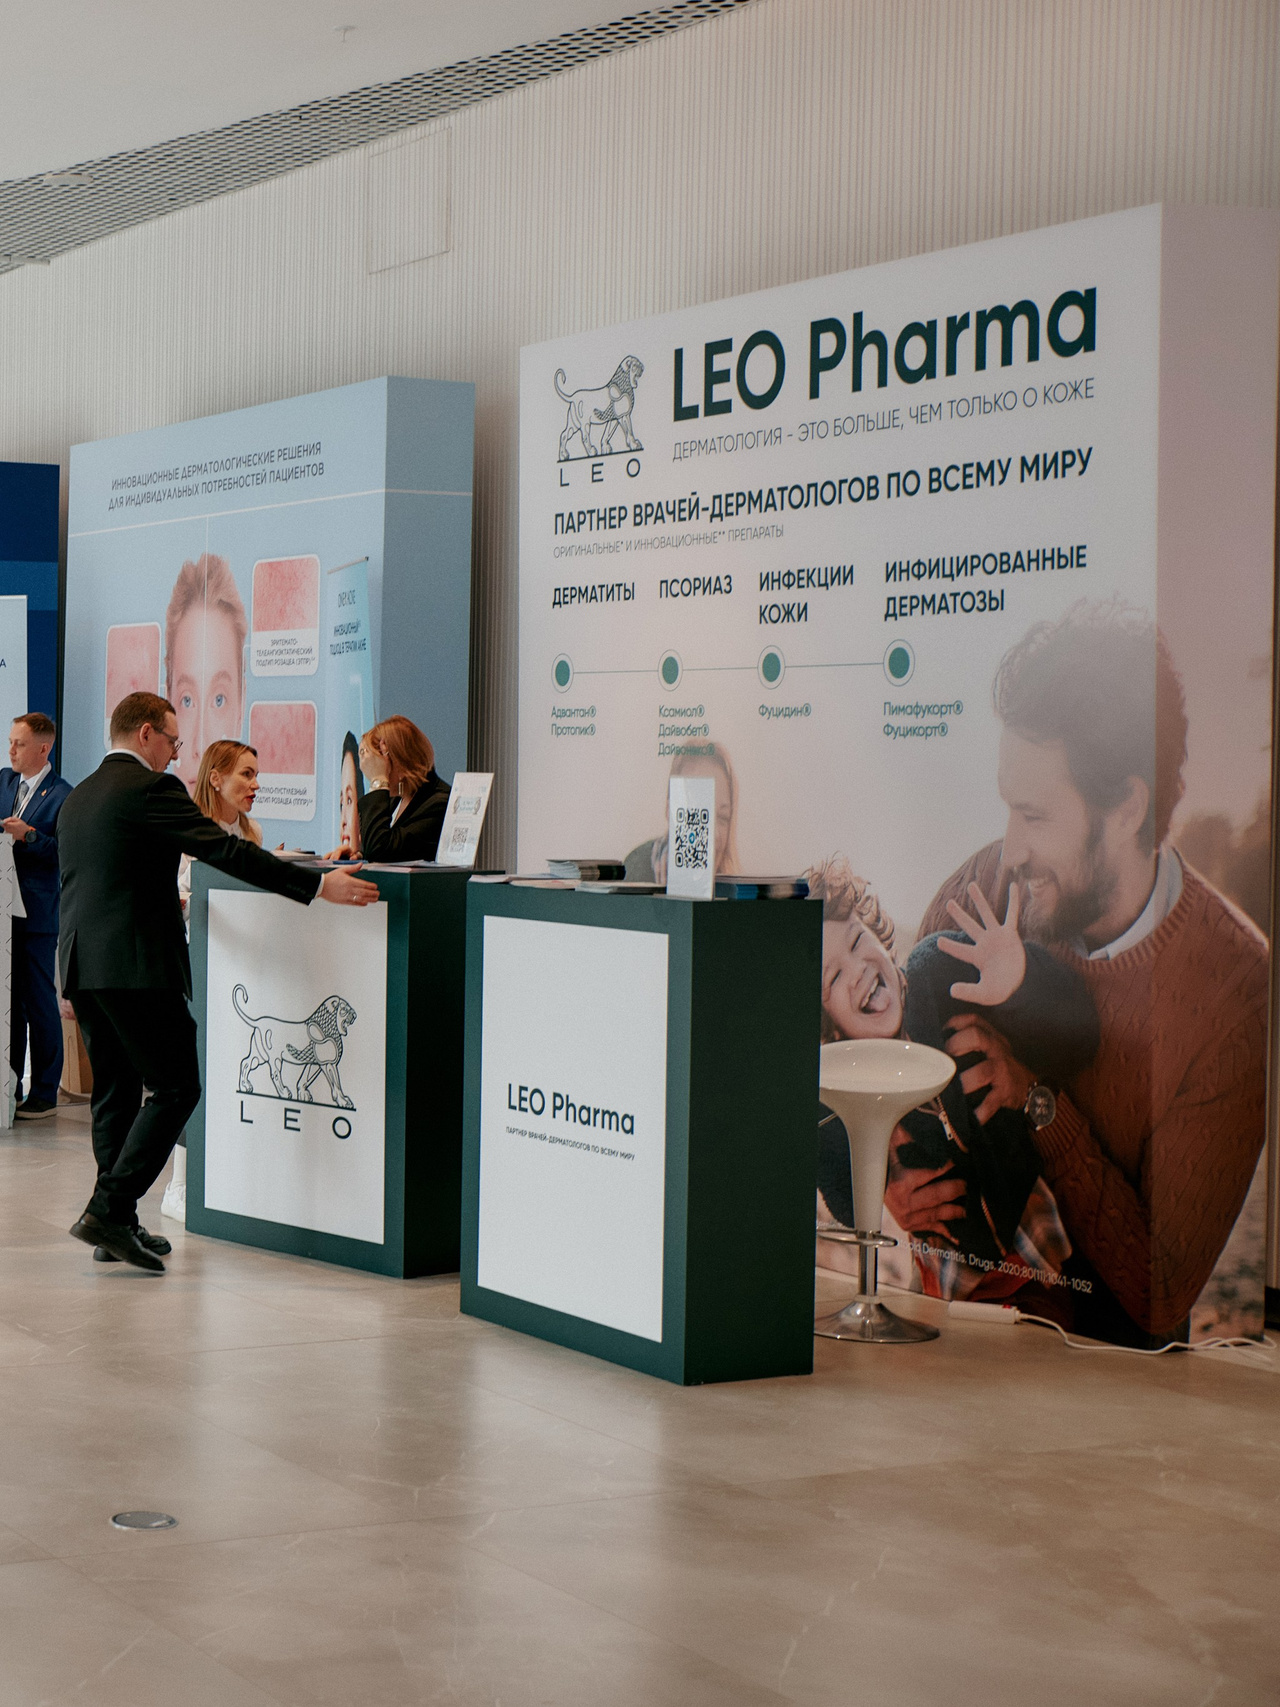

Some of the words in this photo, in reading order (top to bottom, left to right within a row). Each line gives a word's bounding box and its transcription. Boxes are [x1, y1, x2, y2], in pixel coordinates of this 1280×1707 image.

[673, 330, 786, 422] LEO
[809, 287, 1097, 400] Pharma
[673, 426, 783, 462] ДЕРМАТОЛОГИЯ
[798, 419, 829, 442] ЭТО
[834, 408, 904, 437] БОЛЬШЕ,
[909, 403, 942, 425] ЧЕМ
[947, 390, 1018, 419] ТОЛЬКО
[1022, 386, 1038, 408] О
[1043, 377, 1095, 403] КОЖЕ
[111, 467, 180, 491] ИННОВАЦИОННЫЕ
[181, 450, 275, 481] ДЕРМАТОЛОГИЧЕСКИЕ
[277, 441, 321, 462] РЕШЕНИЯ
[560, 458, 641, 487] LEO
[108, 496, 124, 511] ДЛЯ
[125, 482, 199, 507] ИНДИВИДУАЛЬНЫХ
[201, 469, 267, 494] ПОТРЕБНОСТЕЙ
[269, 462, 325, 485] ПАЦИЕНТОВ
[554, 506, 627, 535] ПАРТНЕР
[633, 474, 880, 527] ВРАЧЕЙ-ДЕРМАТОЛОГОВ
[887, 469, 920, 497] ПО
[928, 457, 1012, 495] ВСЕМУ
[1020, 446, 1093, 483] МИРУ
[625, 538, 632, 552] И
[728, 524, 784, 543] ПРЕПАРАТЫ
[759, 564, 854, 592] ИНФЕКЦИИ
[885, 544, 1087, 582] ИНФИЦИРОВАННЫЕ
[552, 582, 635, 609] ДЕРМАТИТЫ
[659, 574, 733, 599] ПСОРИАЗ
[759, 602, 808, 624] КОЖИ
[884, 589, 1005, 621] ДЕРМАТОЗЫ
[255, 796, 271, 804] ОДТИП
[257, 786, 307, 796] АПУЛО-ПУСТУЛЕЗНЫЙ
[240, 1100, 352, 1139] LEO
[508, 1083, 545, 1116] LEO
[552, 1091, 635, 1135] Pharma
[506, 1126, 528, 1137] ПАРТНЕР
[528, 1131, 591, 1152] ВРАЧЕЙ-ДЕРМАТОЛОГОВ
[591, 1144, 600, 1154] ПО
[600, 1146, 619, 1158] ВСЕМУ
[619, 1151, 636, 1161] МИРУ
